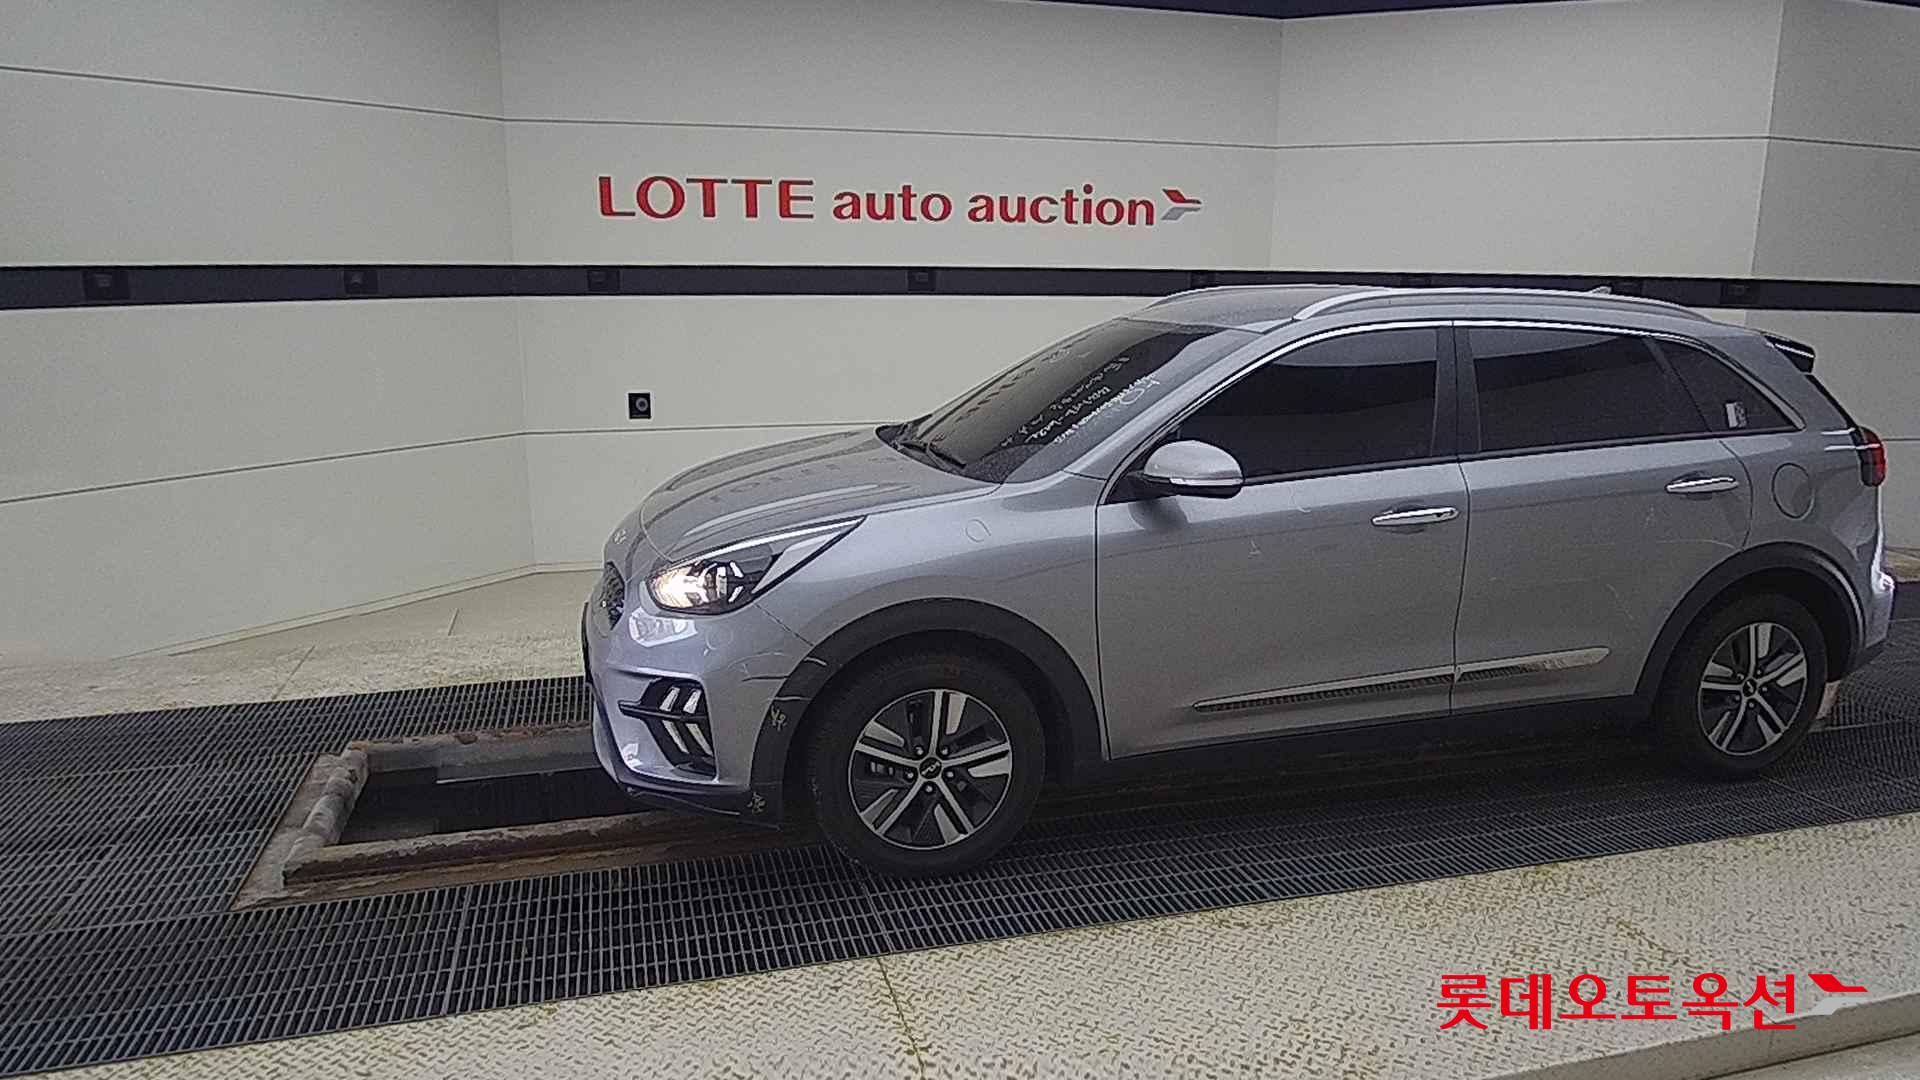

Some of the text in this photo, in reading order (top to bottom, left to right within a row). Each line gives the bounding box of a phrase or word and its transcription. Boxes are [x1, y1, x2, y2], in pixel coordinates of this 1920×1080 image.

[599, 175, 1155, 227] LOTTE auto auction
